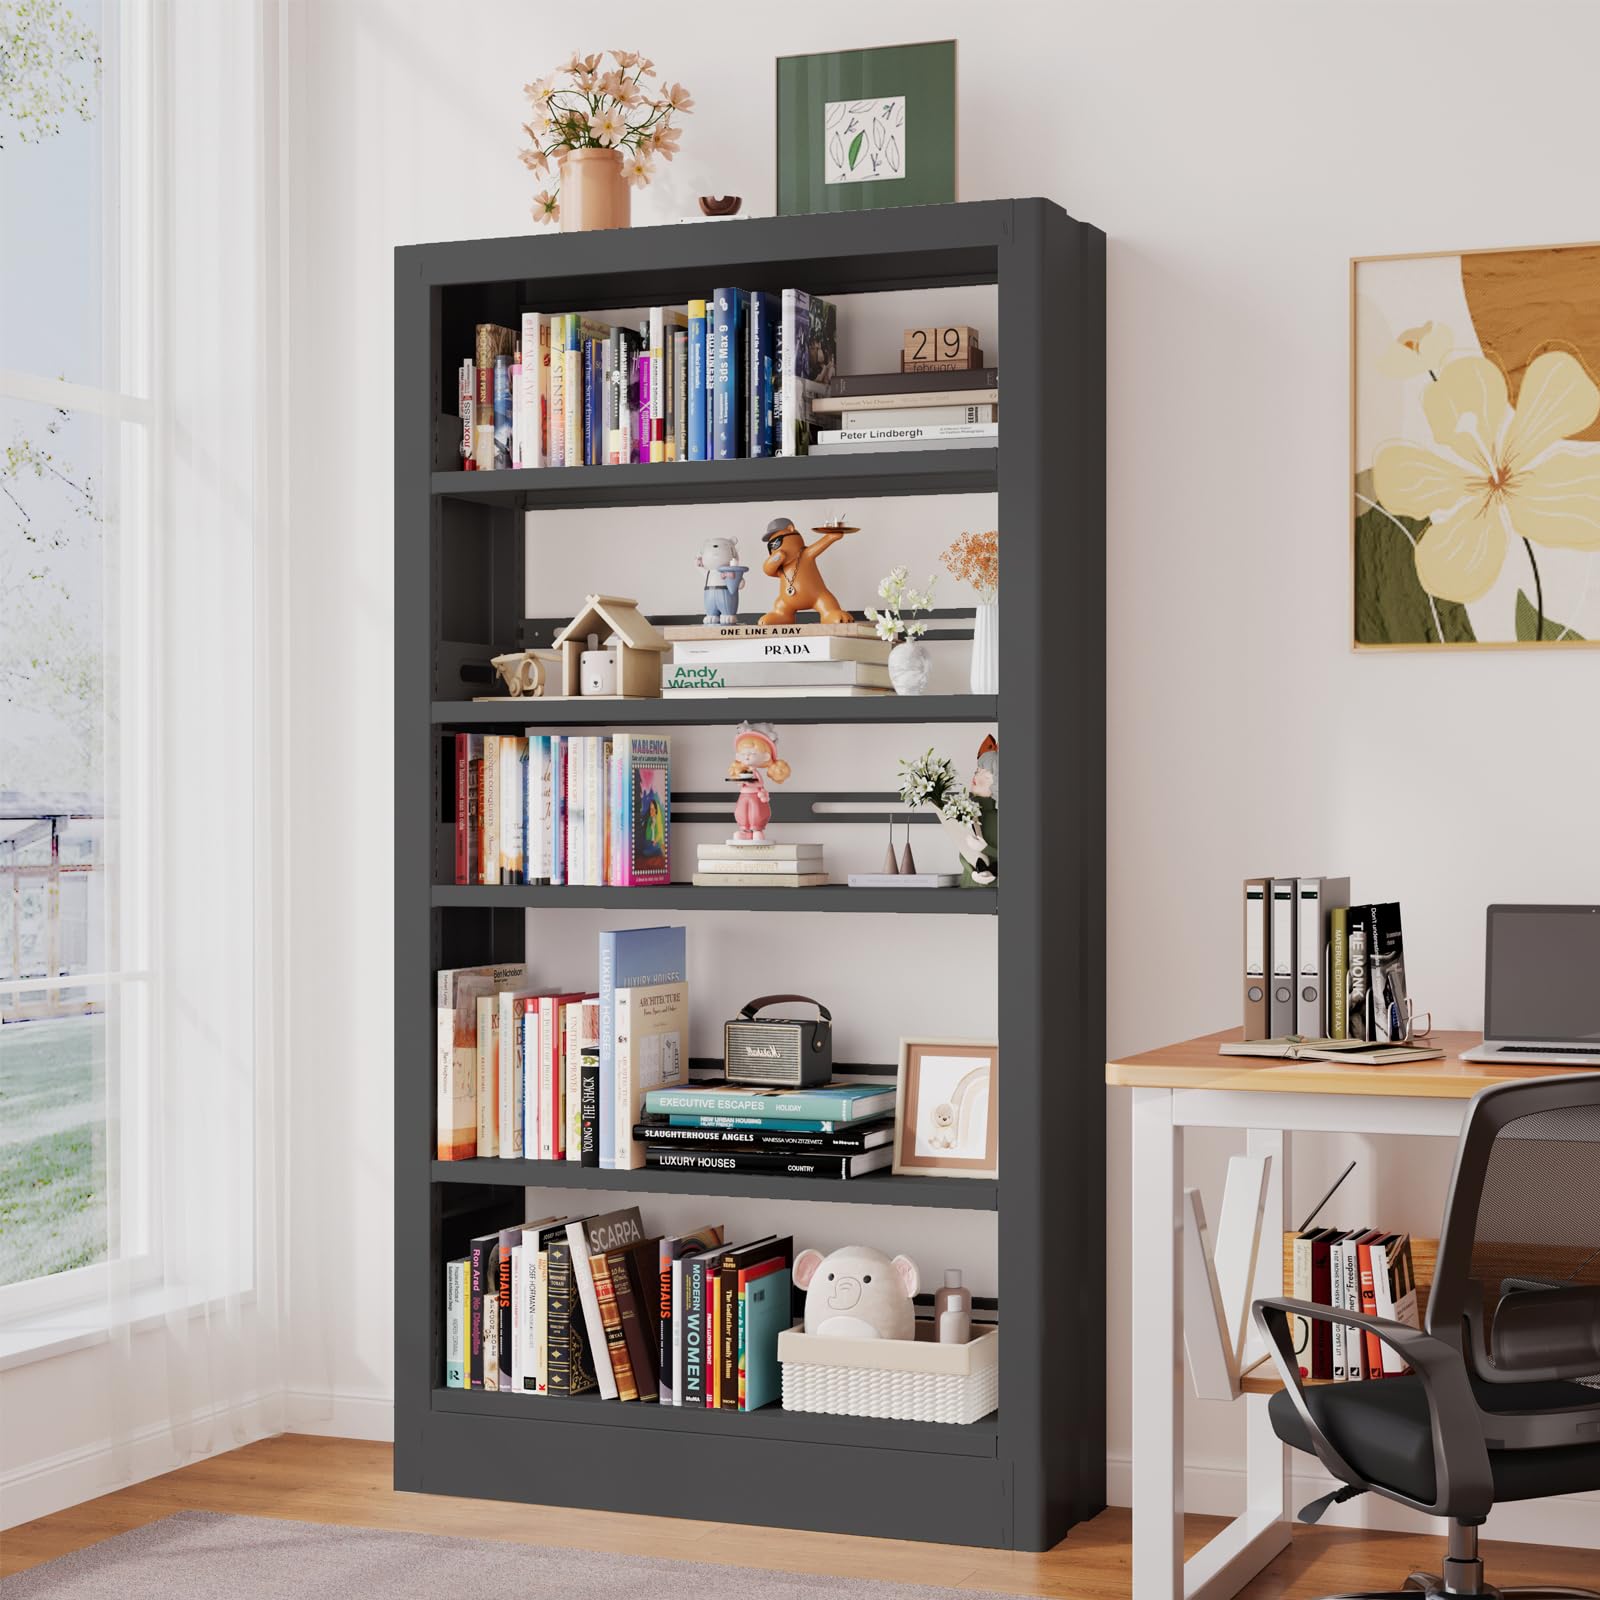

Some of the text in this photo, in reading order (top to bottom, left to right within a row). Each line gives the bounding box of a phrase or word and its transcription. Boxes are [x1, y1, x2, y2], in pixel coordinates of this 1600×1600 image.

[718, 324, 729, 332] 9
[718, 335, 729, 359] Max
[912, 328, 960, 360] 2 9
[706, 333, 714, 389] BUSINESS
[718, 362, 729, 383] 3ds
[553, 366, 564, 416] SENSE
[840, 428, 923, 441] Peter Lindbergh
[720, 627, 802, 637] ONE LINE A DAY
[764, 644, 811, 656] PRADA
[668, 678, 725, 689] Warhol
[675, 666, 718, 681] Andy
[1371, 907, 1379, 924] Don't
[1334, 929, 1342, 967] MATERIAL
[1352, 922, 1365, 998] THE MONK
[493, 969, 503, 979] Ben
[1334, 968, 1342, 998] EDITOR
[602, 949, 611, 1061] LUXURY HOUSES
[1334, 999, 1342, 1010] BY
[581, 1076, 595, 1153] YOUNG THE SHACK
[659, 1097, 802, 1113] EXECUTIVE ESCAPES HOLIDAY
[644, 1129, 720, 1142] SLAUGHTERHOUSE
[722, 1133, 754, 1142] ANGELS
[762, 1136, 785, 1144] VANESSA
[660, 1155, 815, 1172] LUXURY HOUSES COUNTRY
[589, 1219, 641, 1253] SCARPA
[473, 1249, 481, 1267] Ron
[473, 1269, 481, 1291] Arad
[499, 1246, 510, 1307] BAUHAUS
[1346, 1255, 1354, 1288] Freedom
[660, 1255, 671, 1319] BAUHAUS
[692, 1263, 702, 1311] MODERN
[725, 1290, 733, 1302] The
[725, 1303, 733, 1335] Godfather
[687, 1313, 700, 1391] WOMEN
[724, 1337, 733, 1358] Family
